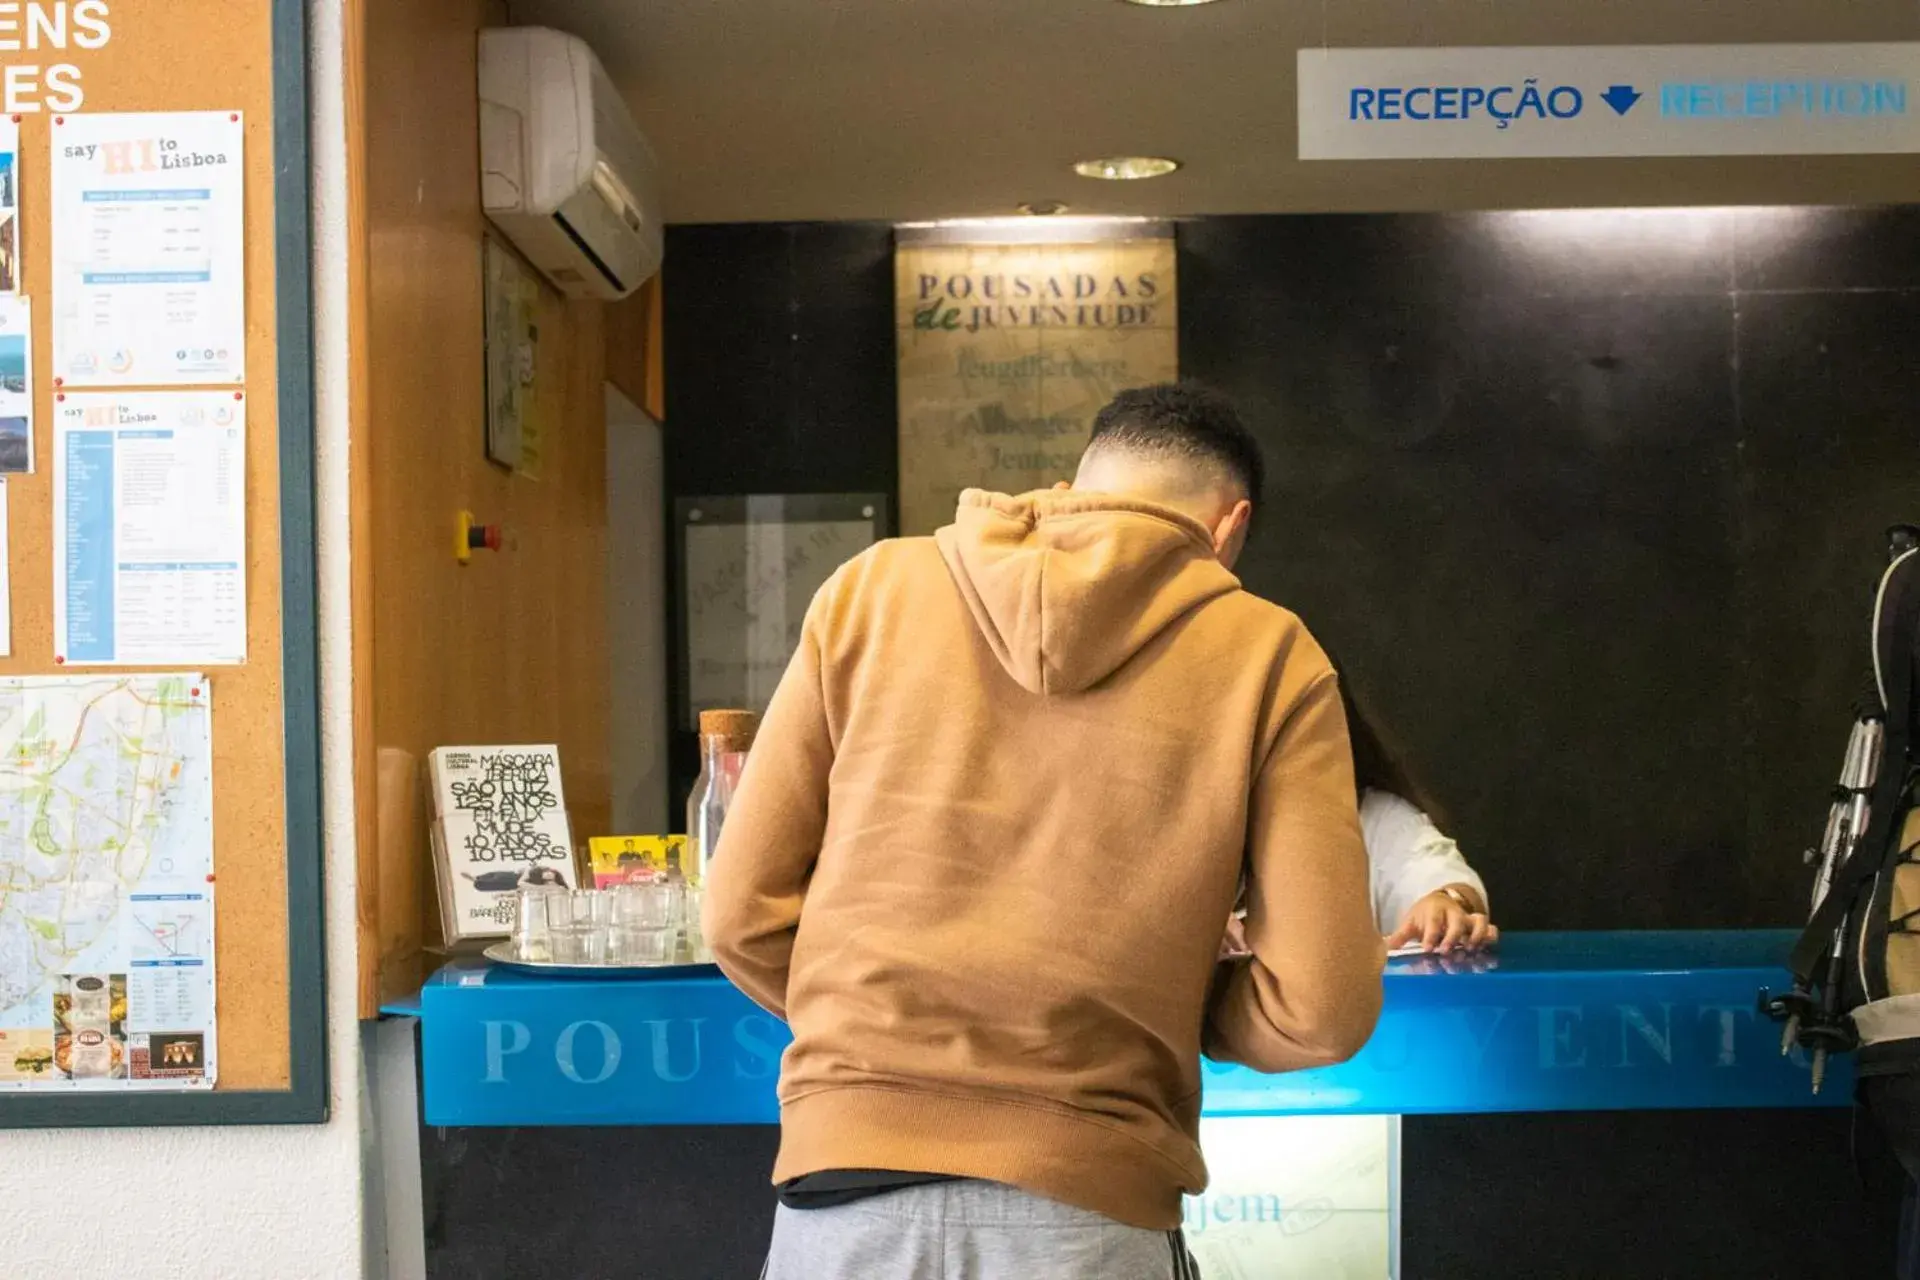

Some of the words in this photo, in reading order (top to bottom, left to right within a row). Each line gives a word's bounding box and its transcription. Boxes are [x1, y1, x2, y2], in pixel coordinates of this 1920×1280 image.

[1350, 79, 1582, 128] RECEPÇÃO
[1660, 80, 1908, 119] RECEPTION
[64, 144, 97, 161] say
[102, 139, 158, 174] HI
[159, 137, 177, 151] to
[160, 151, 227, 169] Lisboa
[919, 273, 1157, 299] POUSADAS
[912, 297, 961, 331] de
[965, 304, 1155, 333] JUVENTUDE
[479, 1016, 778, 1084] POUS
